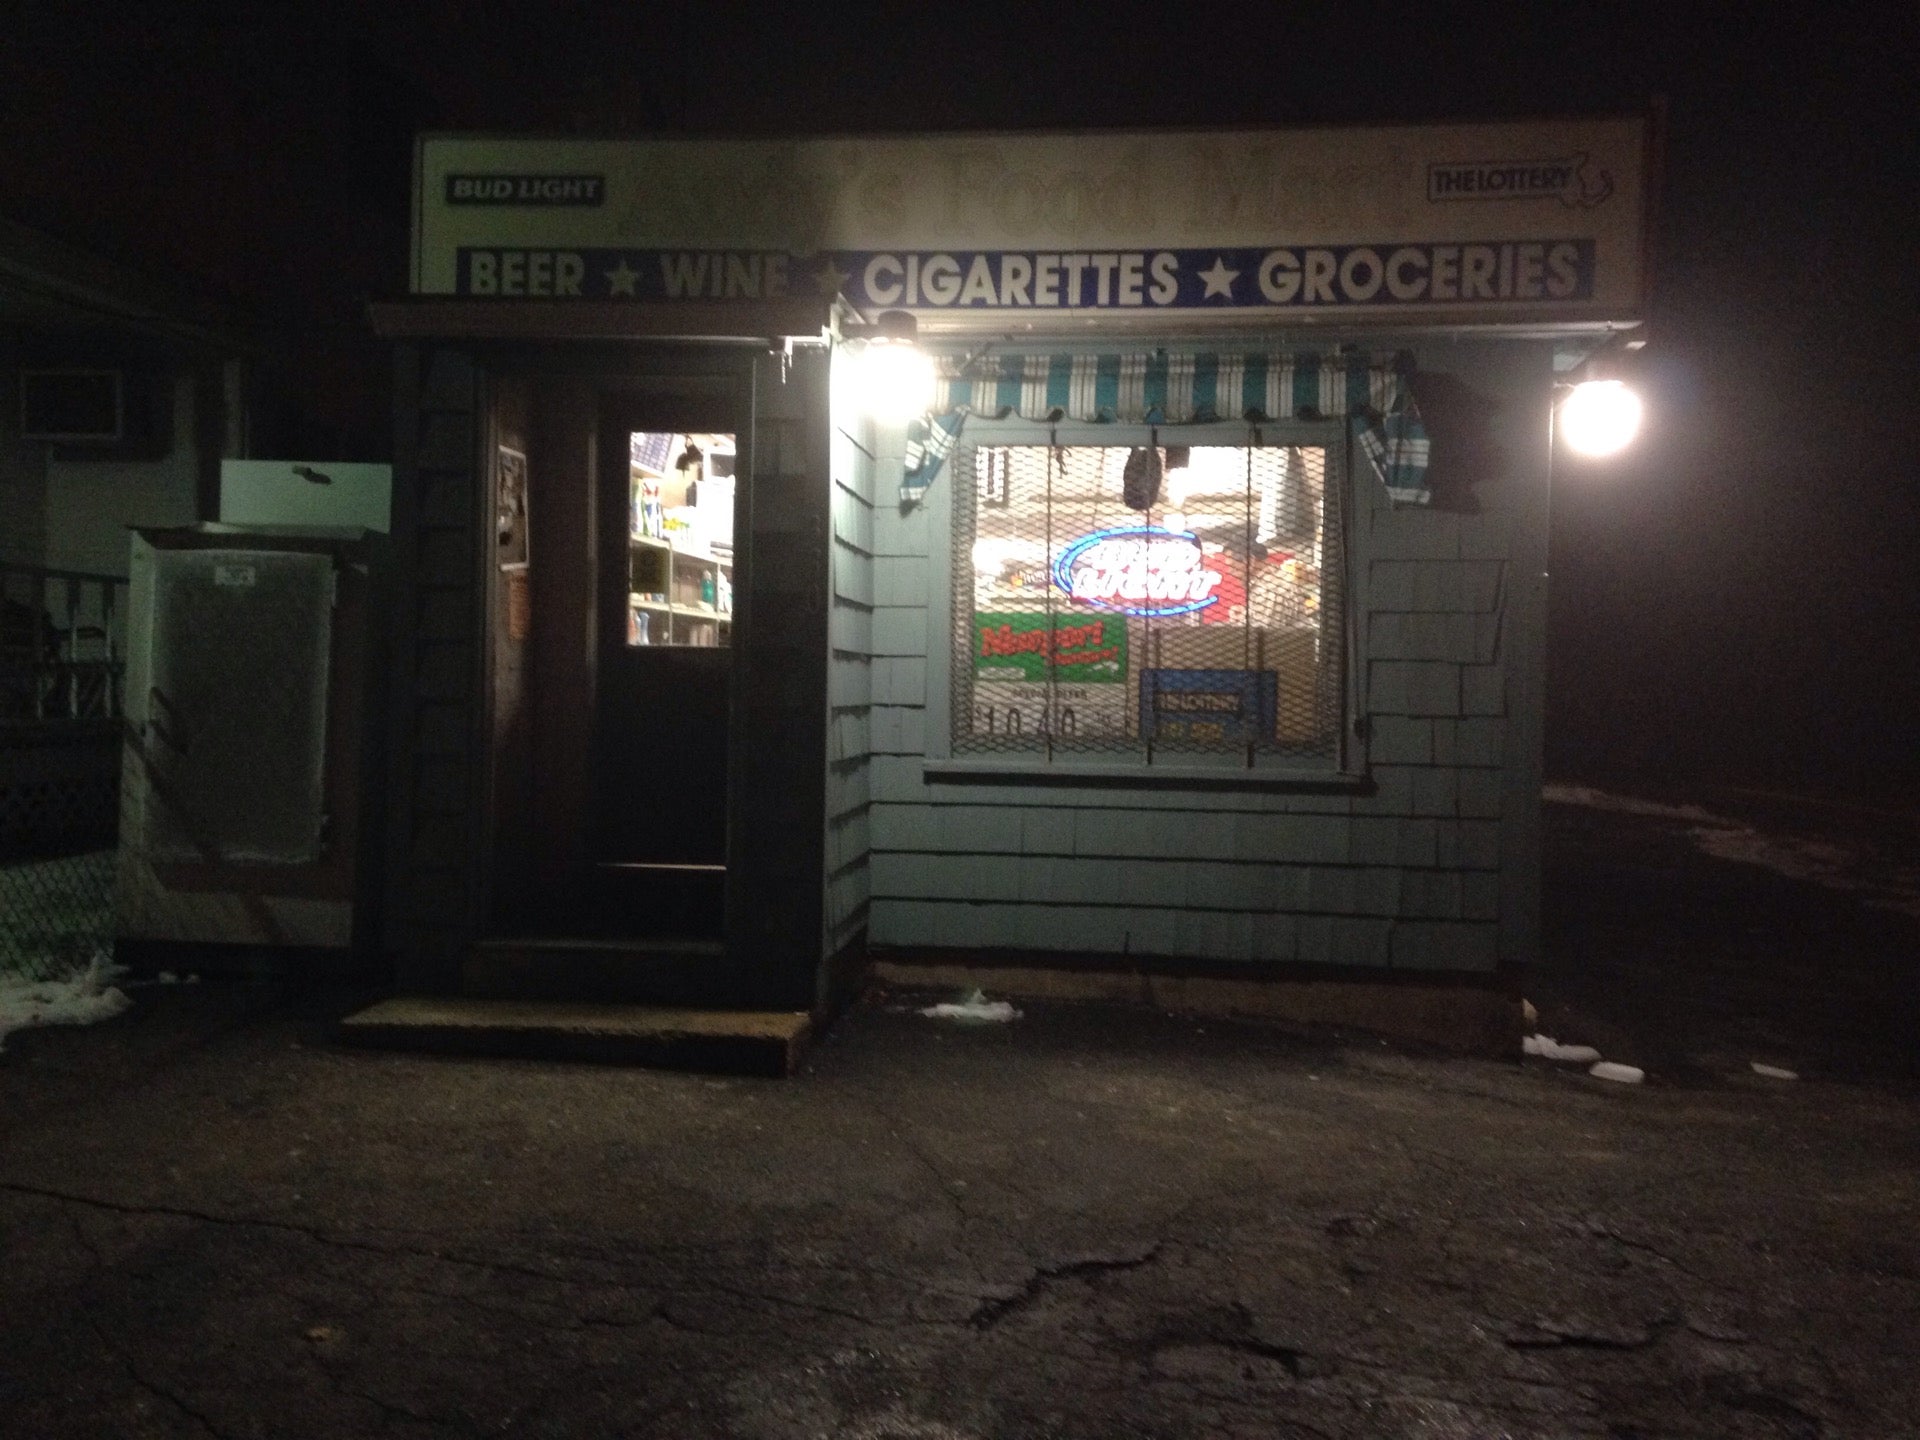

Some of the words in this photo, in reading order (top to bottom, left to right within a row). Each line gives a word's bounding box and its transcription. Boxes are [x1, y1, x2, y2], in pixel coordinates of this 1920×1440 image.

[453, 178, 513, 199] BUD
[518, 178, 600, 199] LIGHT
[1434, 169, 1477, 193] THE
[1478, 166, 1571, 191] LOTTERY
[469, 250, 585, 297] BEER
[659, 252, 790, 299] WINE
[863, 251, 1180, 306] CIGARETTES
[1258, 243, 1580, 303] GROCERIES
